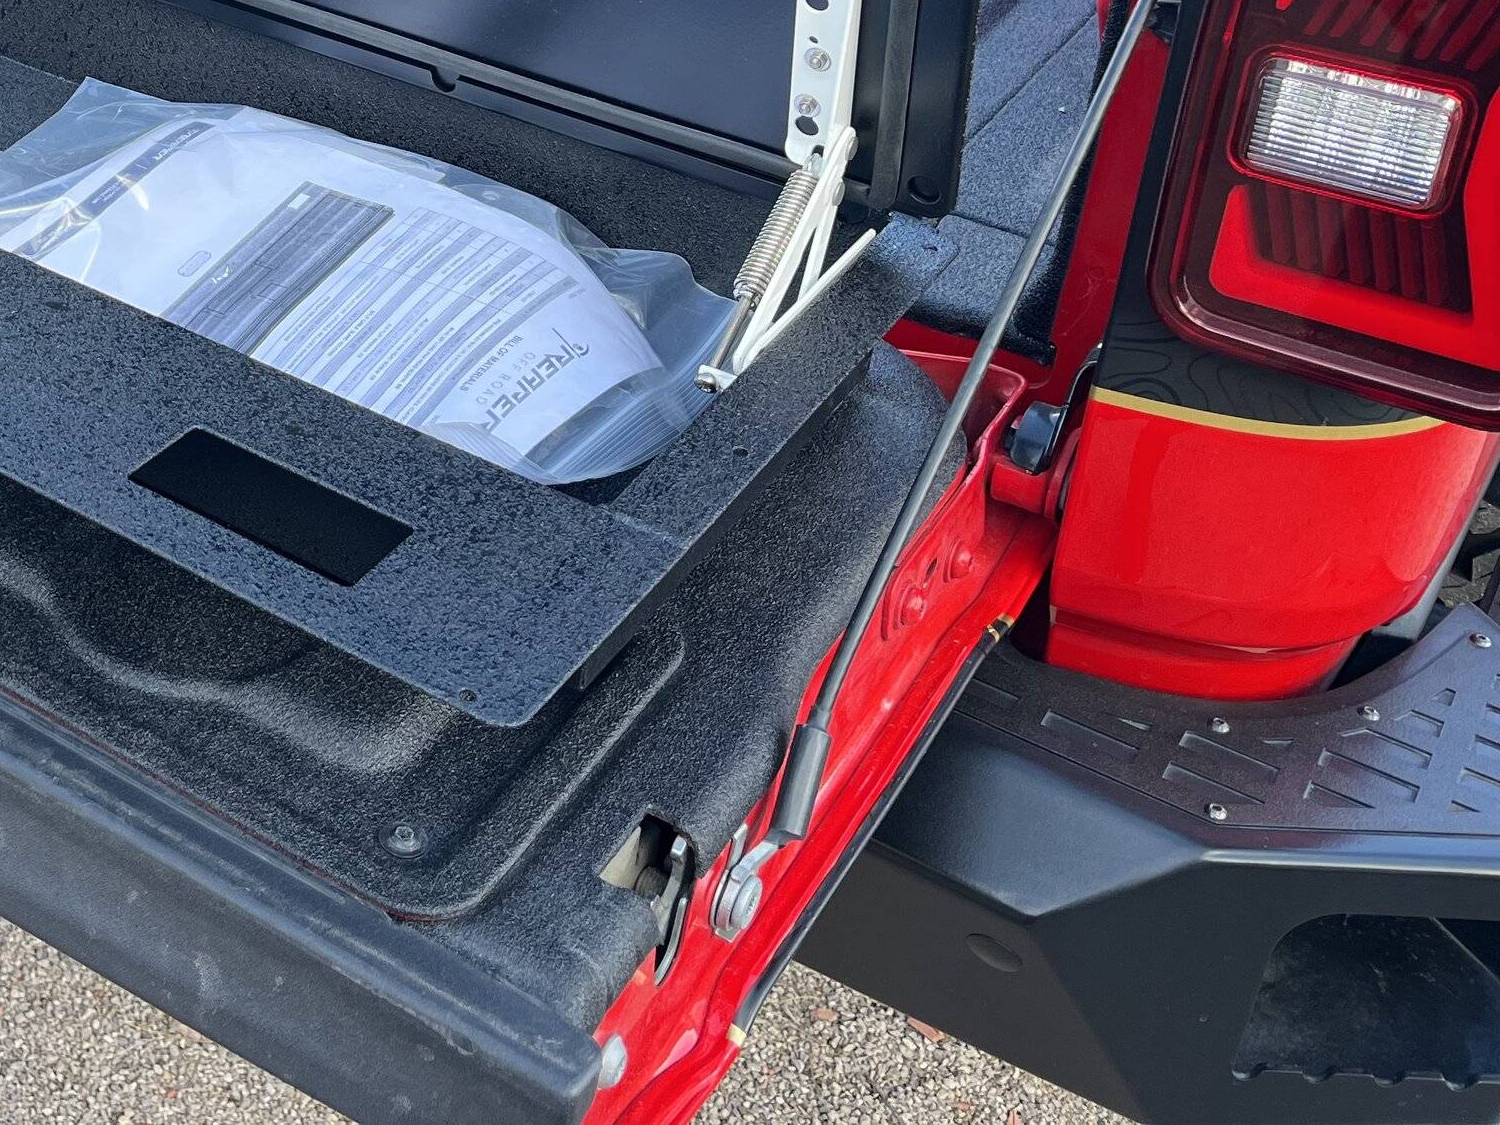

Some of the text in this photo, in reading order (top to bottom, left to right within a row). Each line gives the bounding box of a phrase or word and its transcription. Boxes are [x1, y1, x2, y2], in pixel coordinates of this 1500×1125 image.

[459, 333, 523, 393] BILL OF MATERIALS
[474, 350, 536, 406] OFF ROAD
